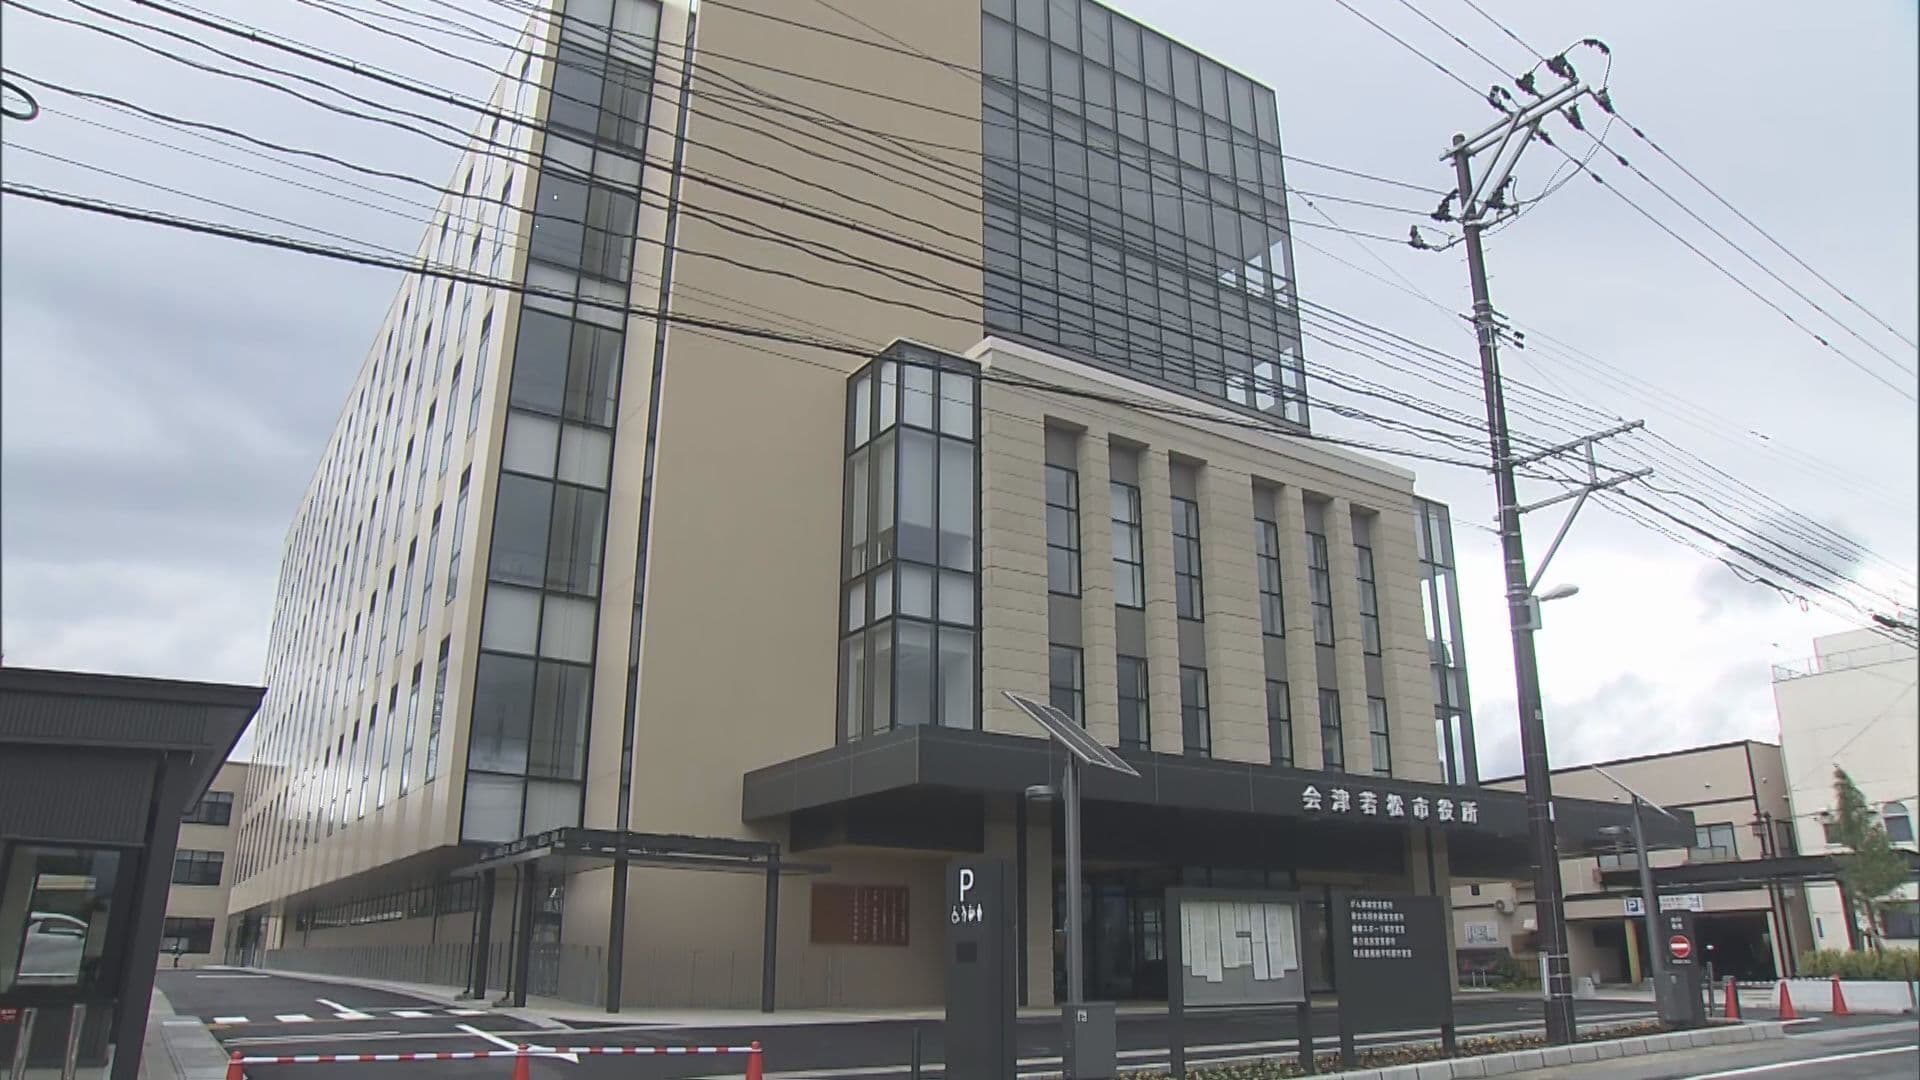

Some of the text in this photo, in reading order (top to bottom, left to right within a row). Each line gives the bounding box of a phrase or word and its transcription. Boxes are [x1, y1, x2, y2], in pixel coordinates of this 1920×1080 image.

[1302, 785, 1479, 824] 会津若松市役所
[960, 869, 974, 902] P
